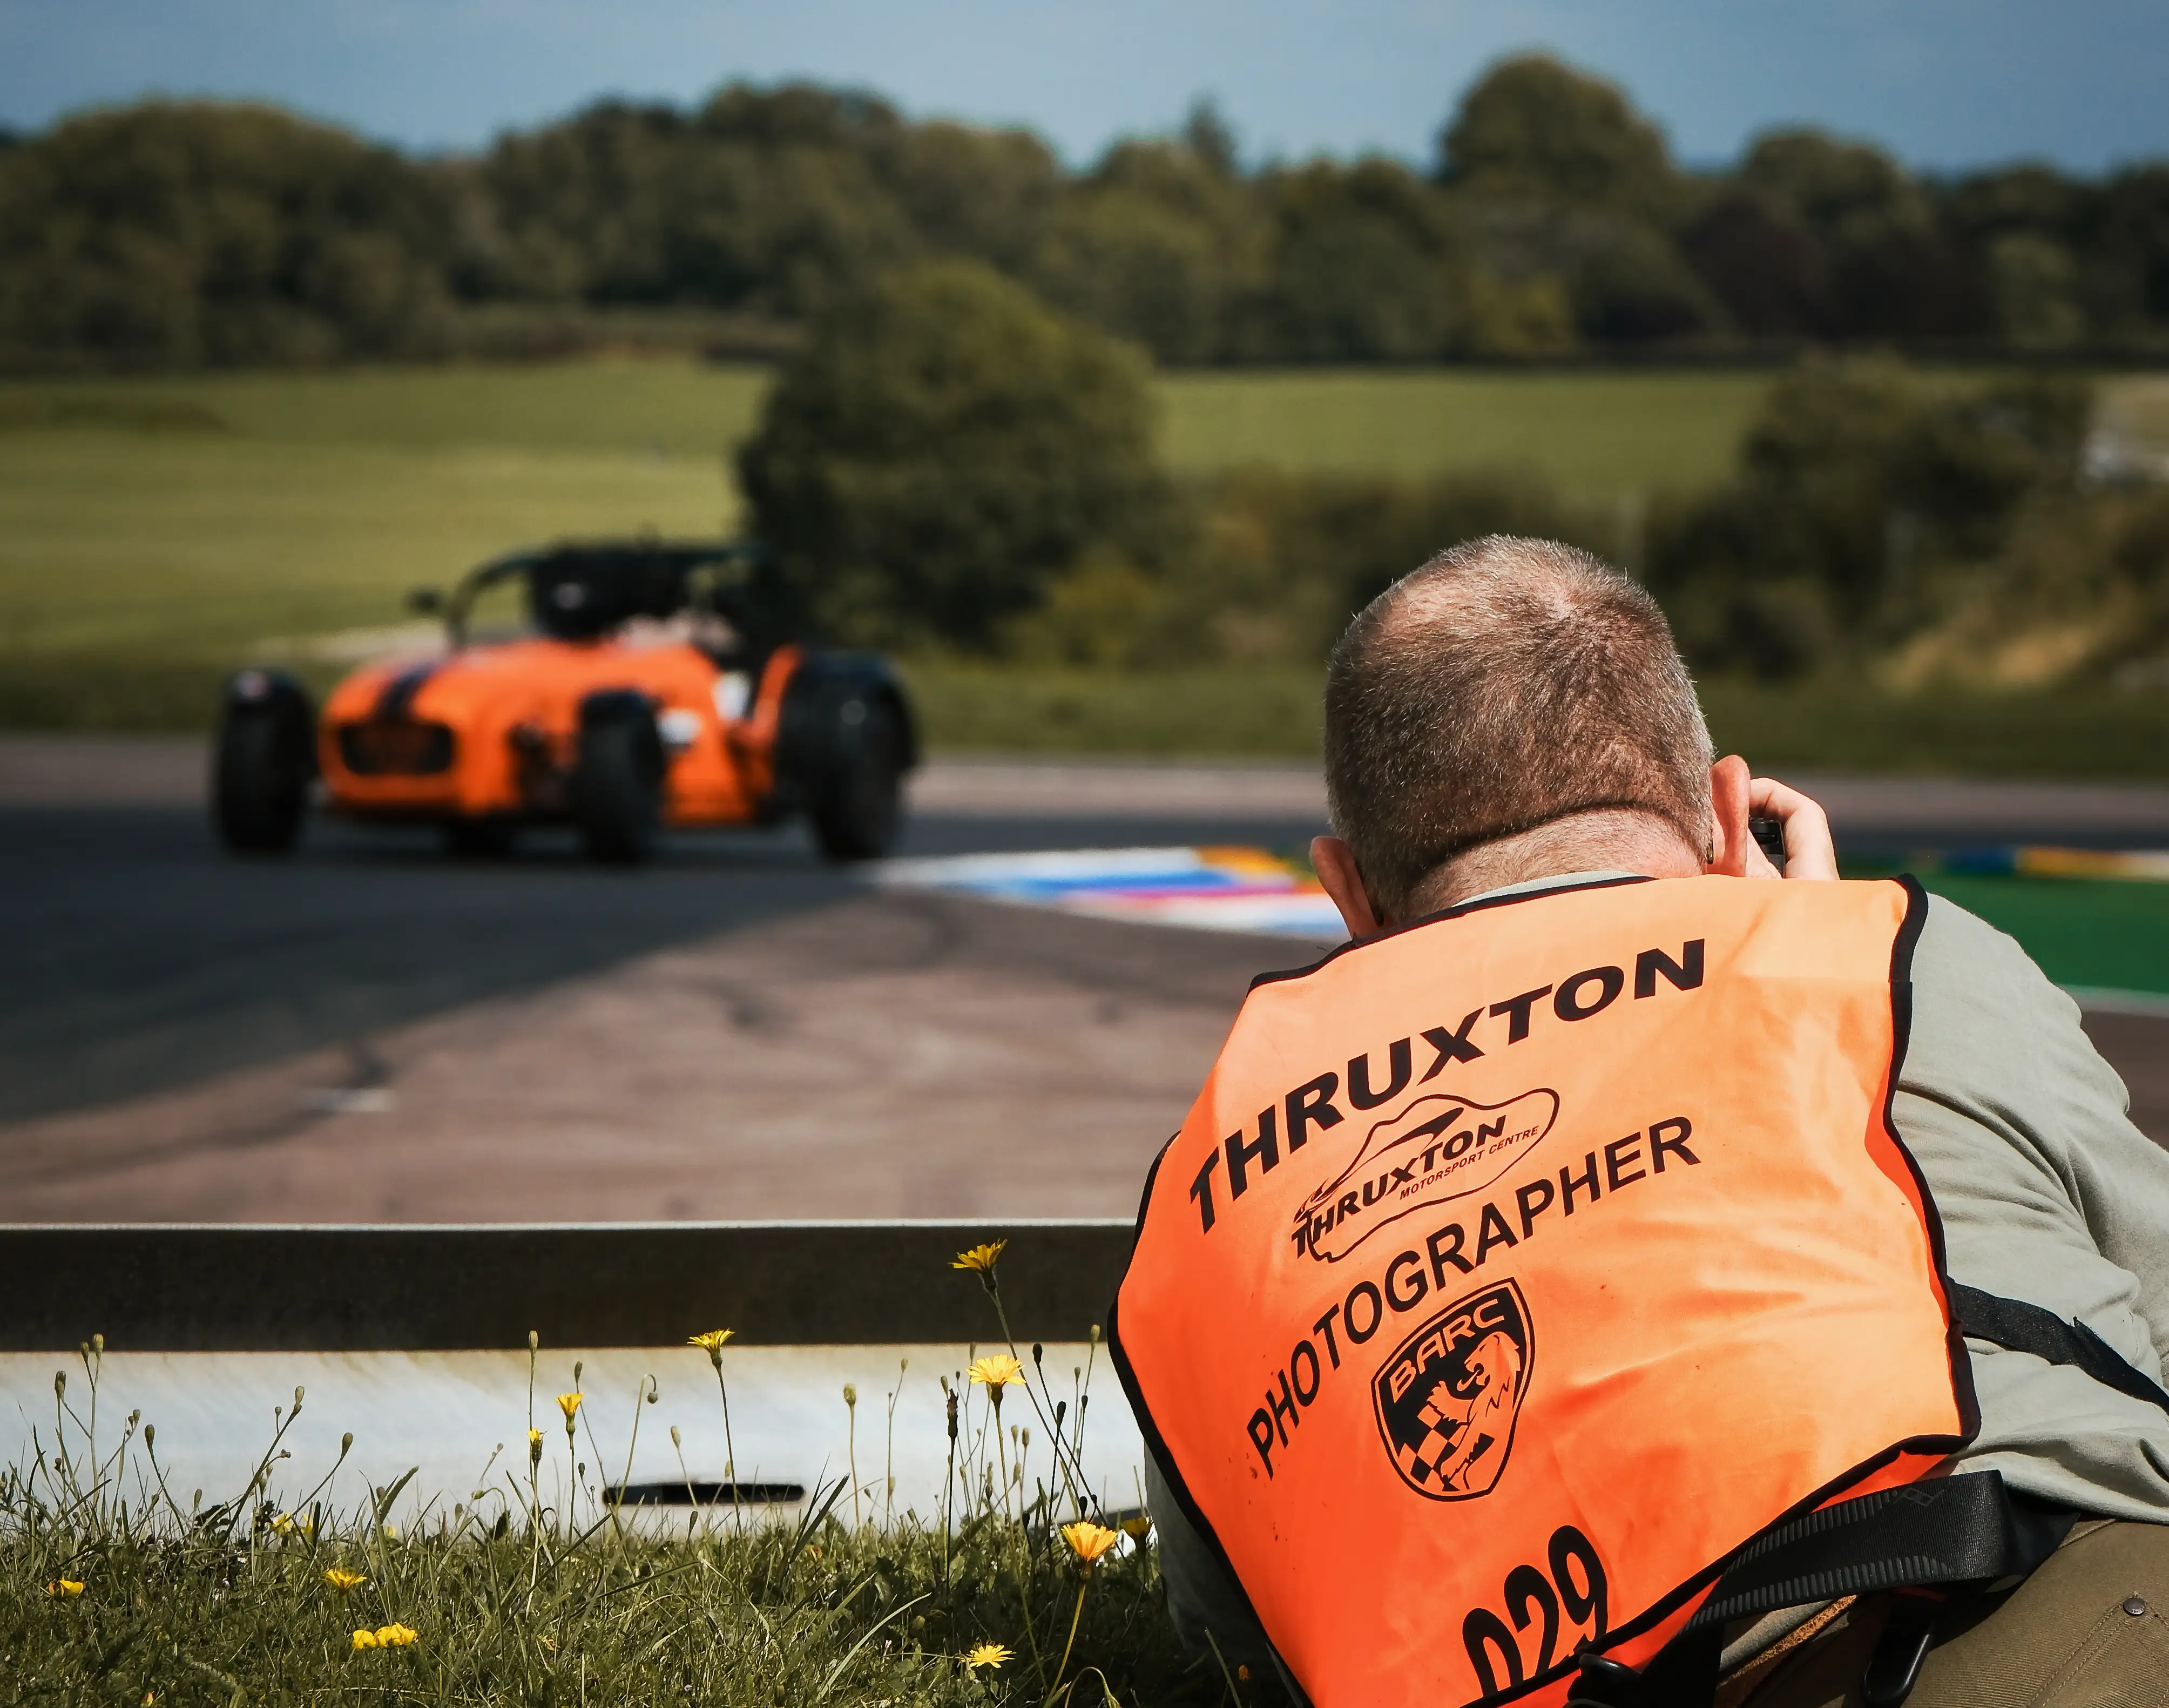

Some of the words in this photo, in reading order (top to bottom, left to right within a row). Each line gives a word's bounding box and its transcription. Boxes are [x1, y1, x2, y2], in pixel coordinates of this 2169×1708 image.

[1190, 939, 1706, 1235] THRUXTON
[1399, 1149, 1485, 1200] MOTORSPORT
[1489, 1125, 1539, 1155] CENTRE
[1291, 1115, 1506, 1259] THRUXTON
[1246, 1116, 1701, 1481] PHOTOGRAPHER
[1389, 1298, 1505, 1403] BARC
[1462, 1525, 1608, 1697] 029
